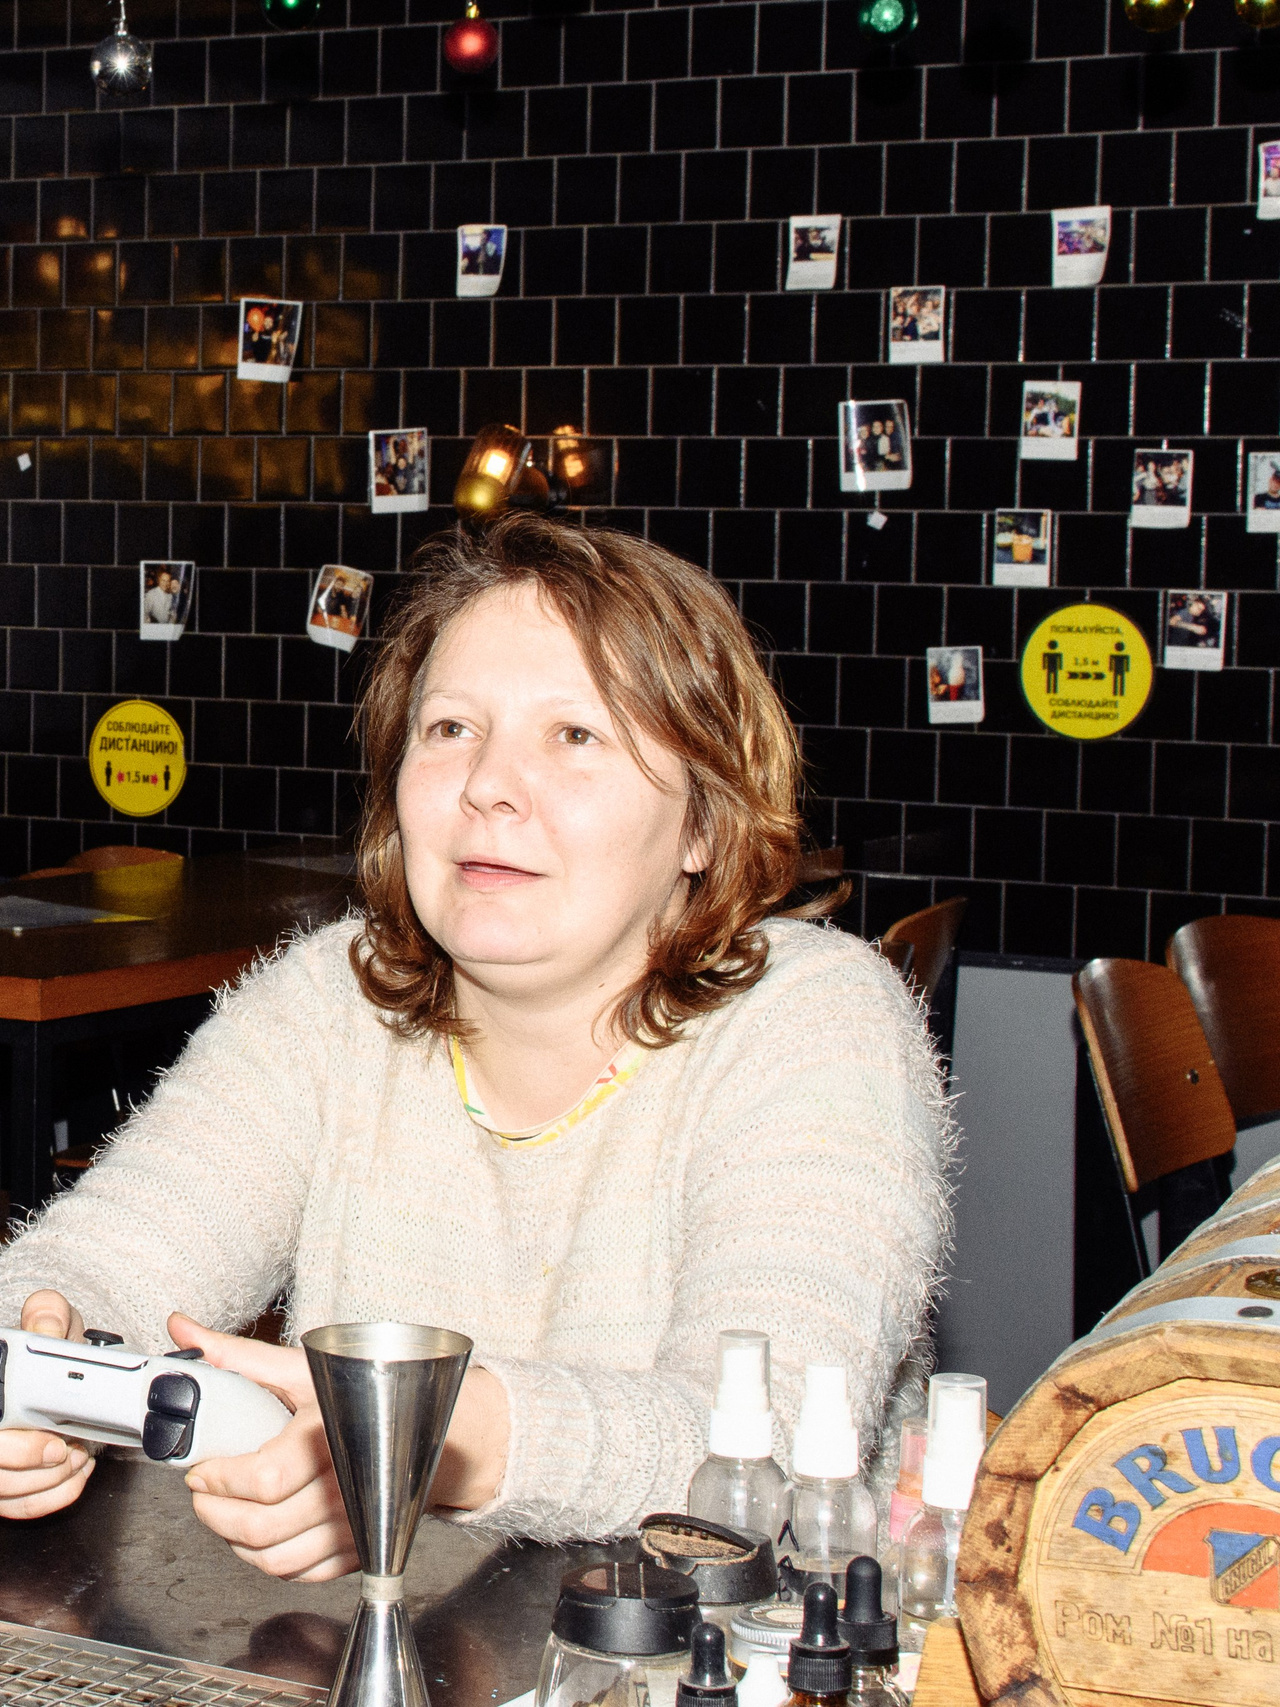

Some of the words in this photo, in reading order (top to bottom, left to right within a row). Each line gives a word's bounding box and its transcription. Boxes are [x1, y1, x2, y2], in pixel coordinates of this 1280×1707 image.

[1049, 698, 1119, 709] СОБЛЮДАЙТЕ
[106, 720, 171, 735] СОБЛЮДАЙТЕ
[100, 735, 178, 755] ДИСТАНЦИЮ!
